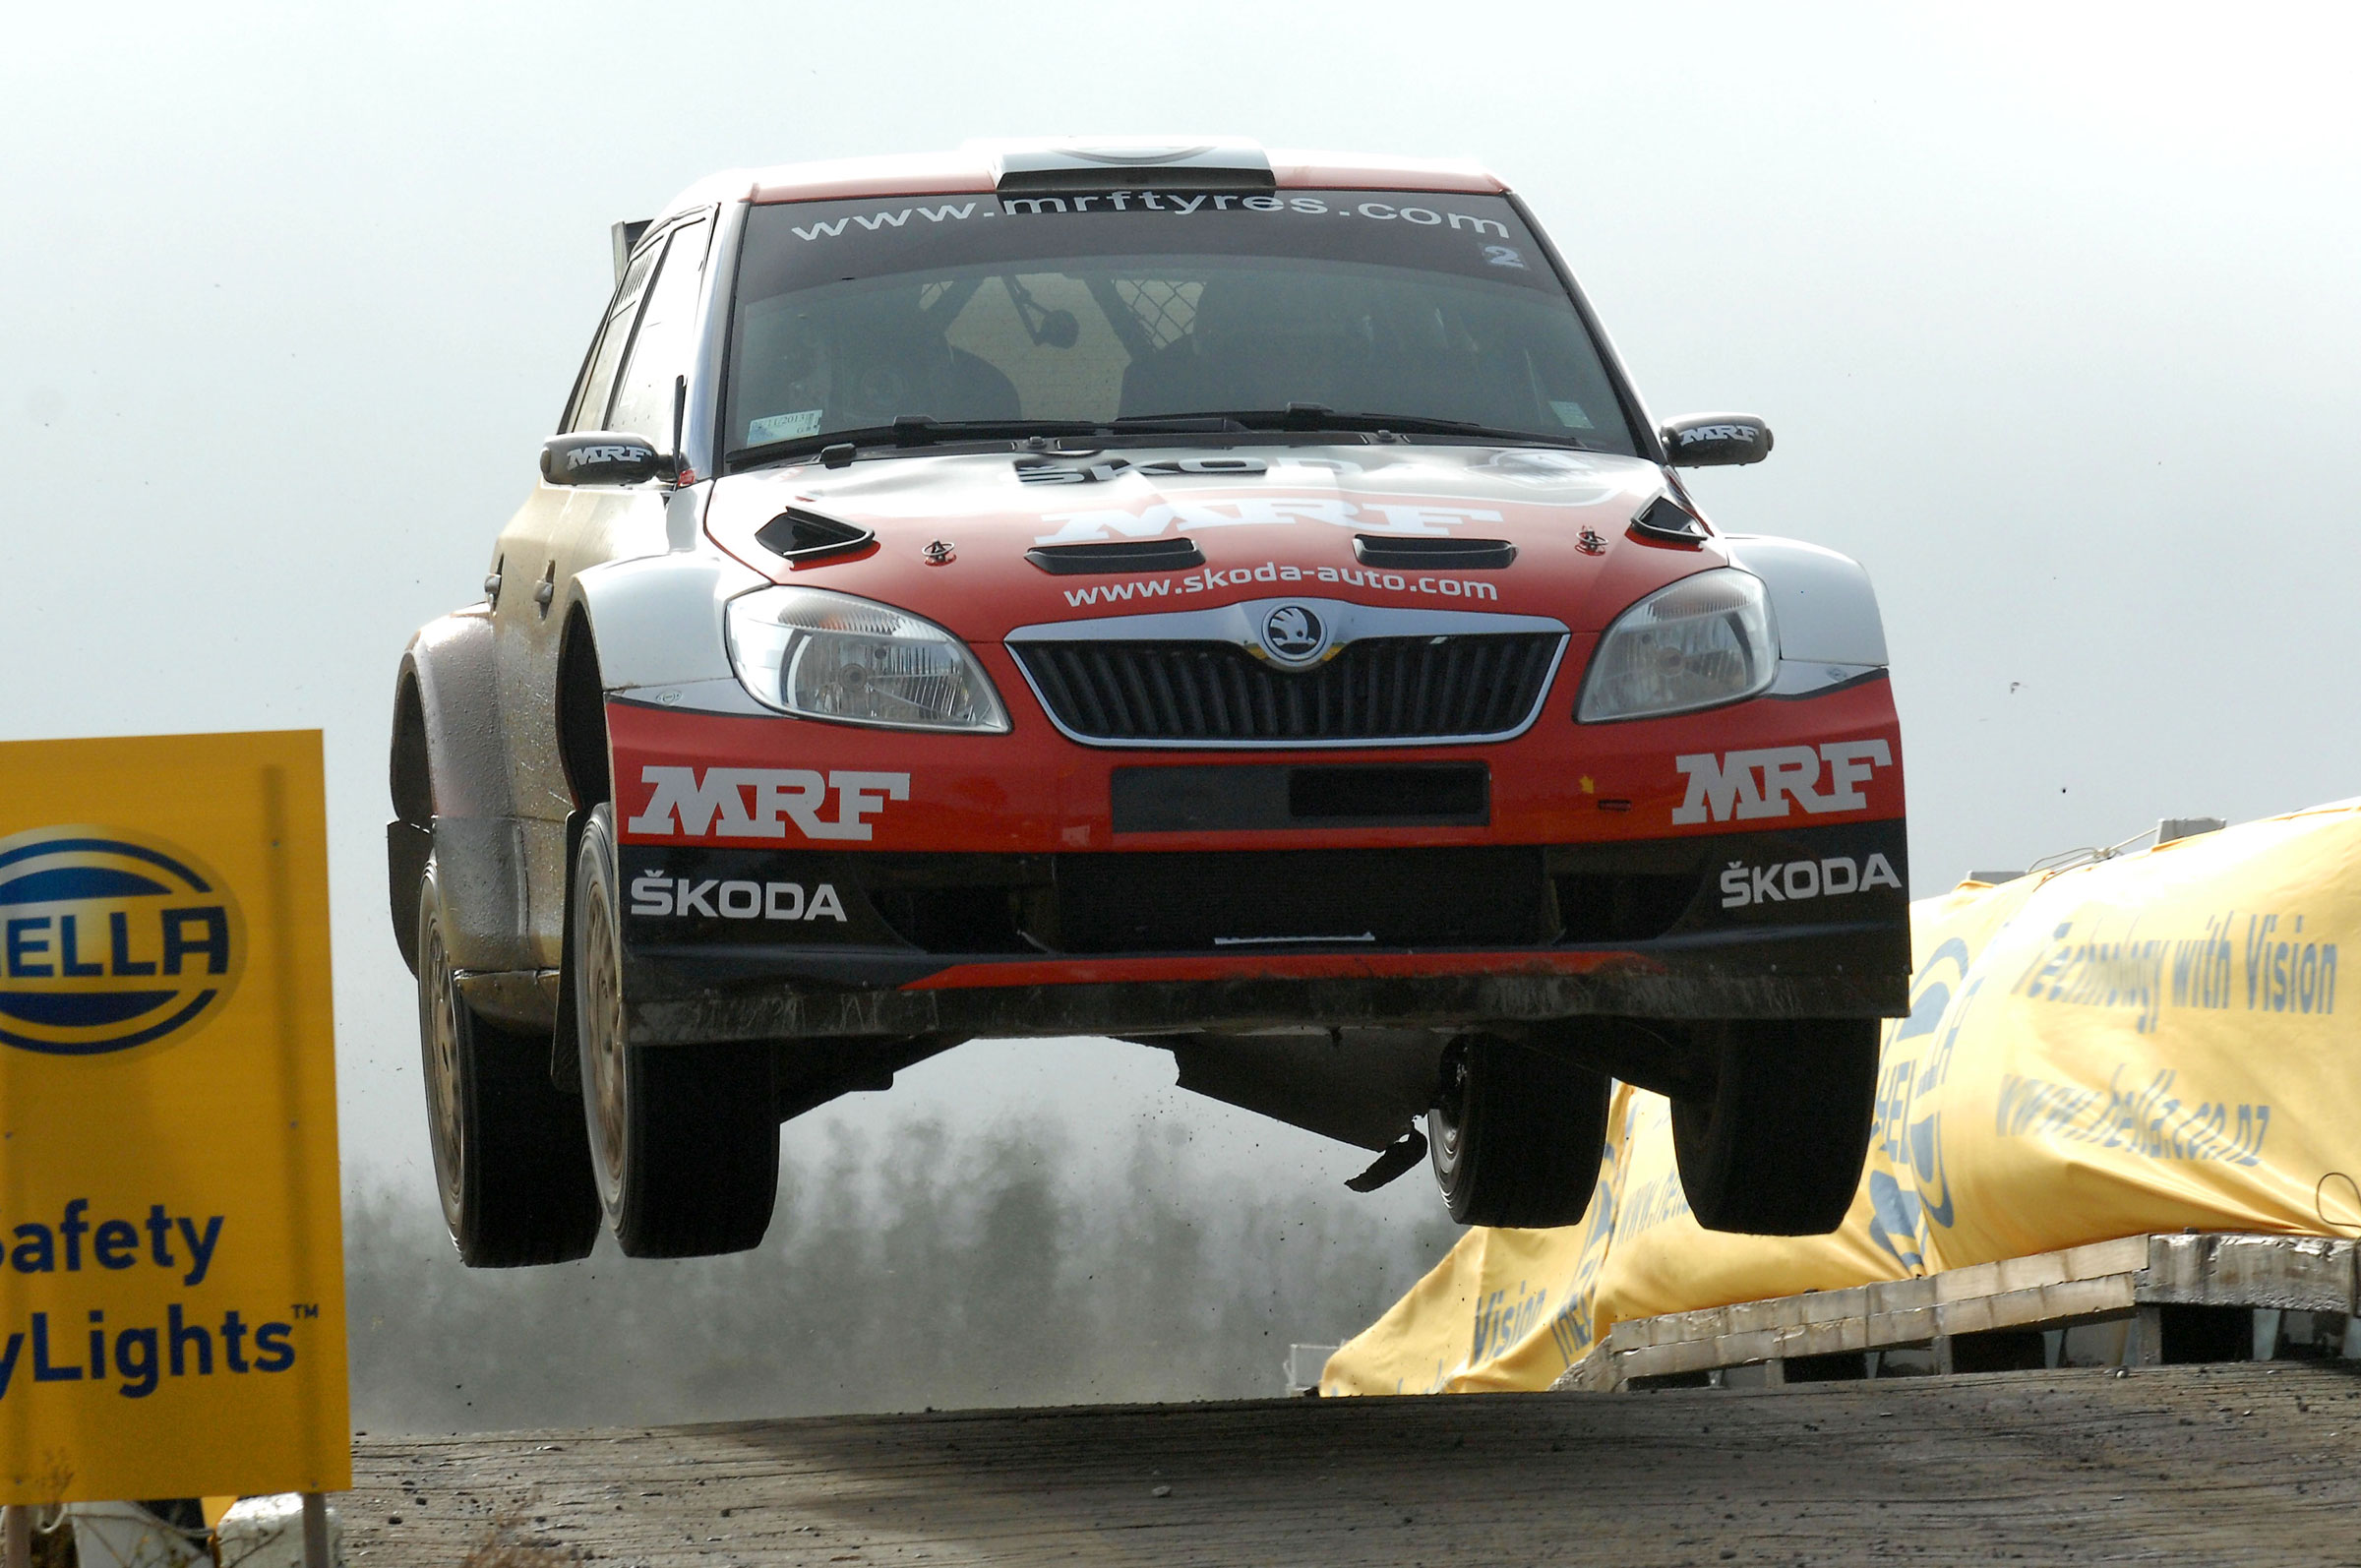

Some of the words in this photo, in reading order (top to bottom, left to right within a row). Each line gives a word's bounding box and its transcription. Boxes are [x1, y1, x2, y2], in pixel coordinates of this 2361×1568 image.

[792, 191, 1510, 241] www.mrftyres.com
[1483, 245, 1525, 270] 2
[567, 446, 653, 470] MRF
[1679, 424, 1760, 446] MRF
[1034, 497, 1503, 546] MRF
[1063, 561, 1498, 608] www.skoda-auto.com
[628, 765, 911, 841] MRF
[1672, 738, 1893, 826] MRF
[631, 870, 848, 922] ŠKODA
[1721, 852, 1902, 908] ŠKODA
[0, 906, 229, 978] ELLA
[2171, 910, 2234, 1009] with
[2245, 914, 2338, 1015] Vision
[0, 1198, 224, 1287] afety
